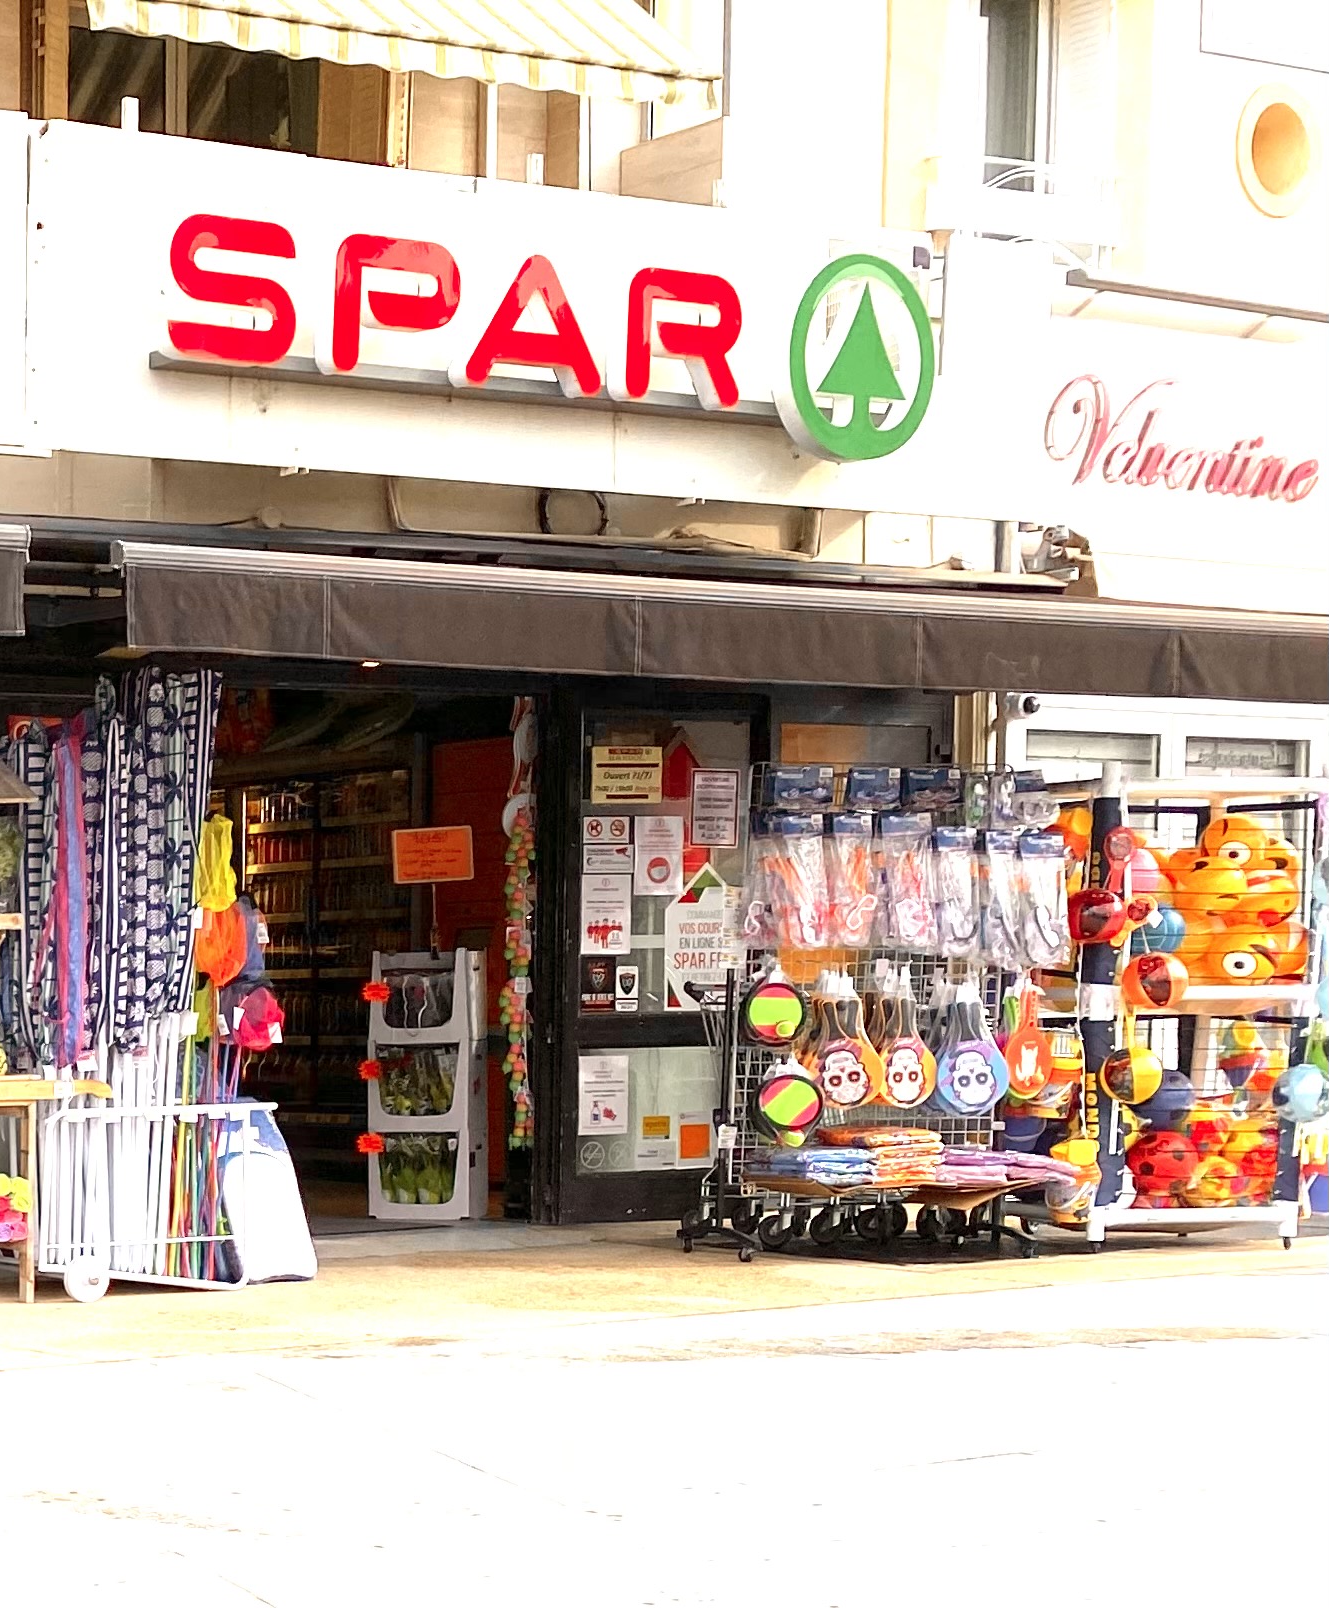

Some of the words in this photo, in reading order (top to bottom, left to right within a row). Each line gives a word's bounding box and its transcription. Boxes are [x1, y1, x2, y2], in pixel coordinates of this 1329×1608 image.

[164, 212, 744, 410] SPAR
[603, 771, 630, 780] Ouvert
[678, 920, 696, 935] VOS
[679, 936, 691, 950] EN
[692, 936, 715, 949] LIGNE
